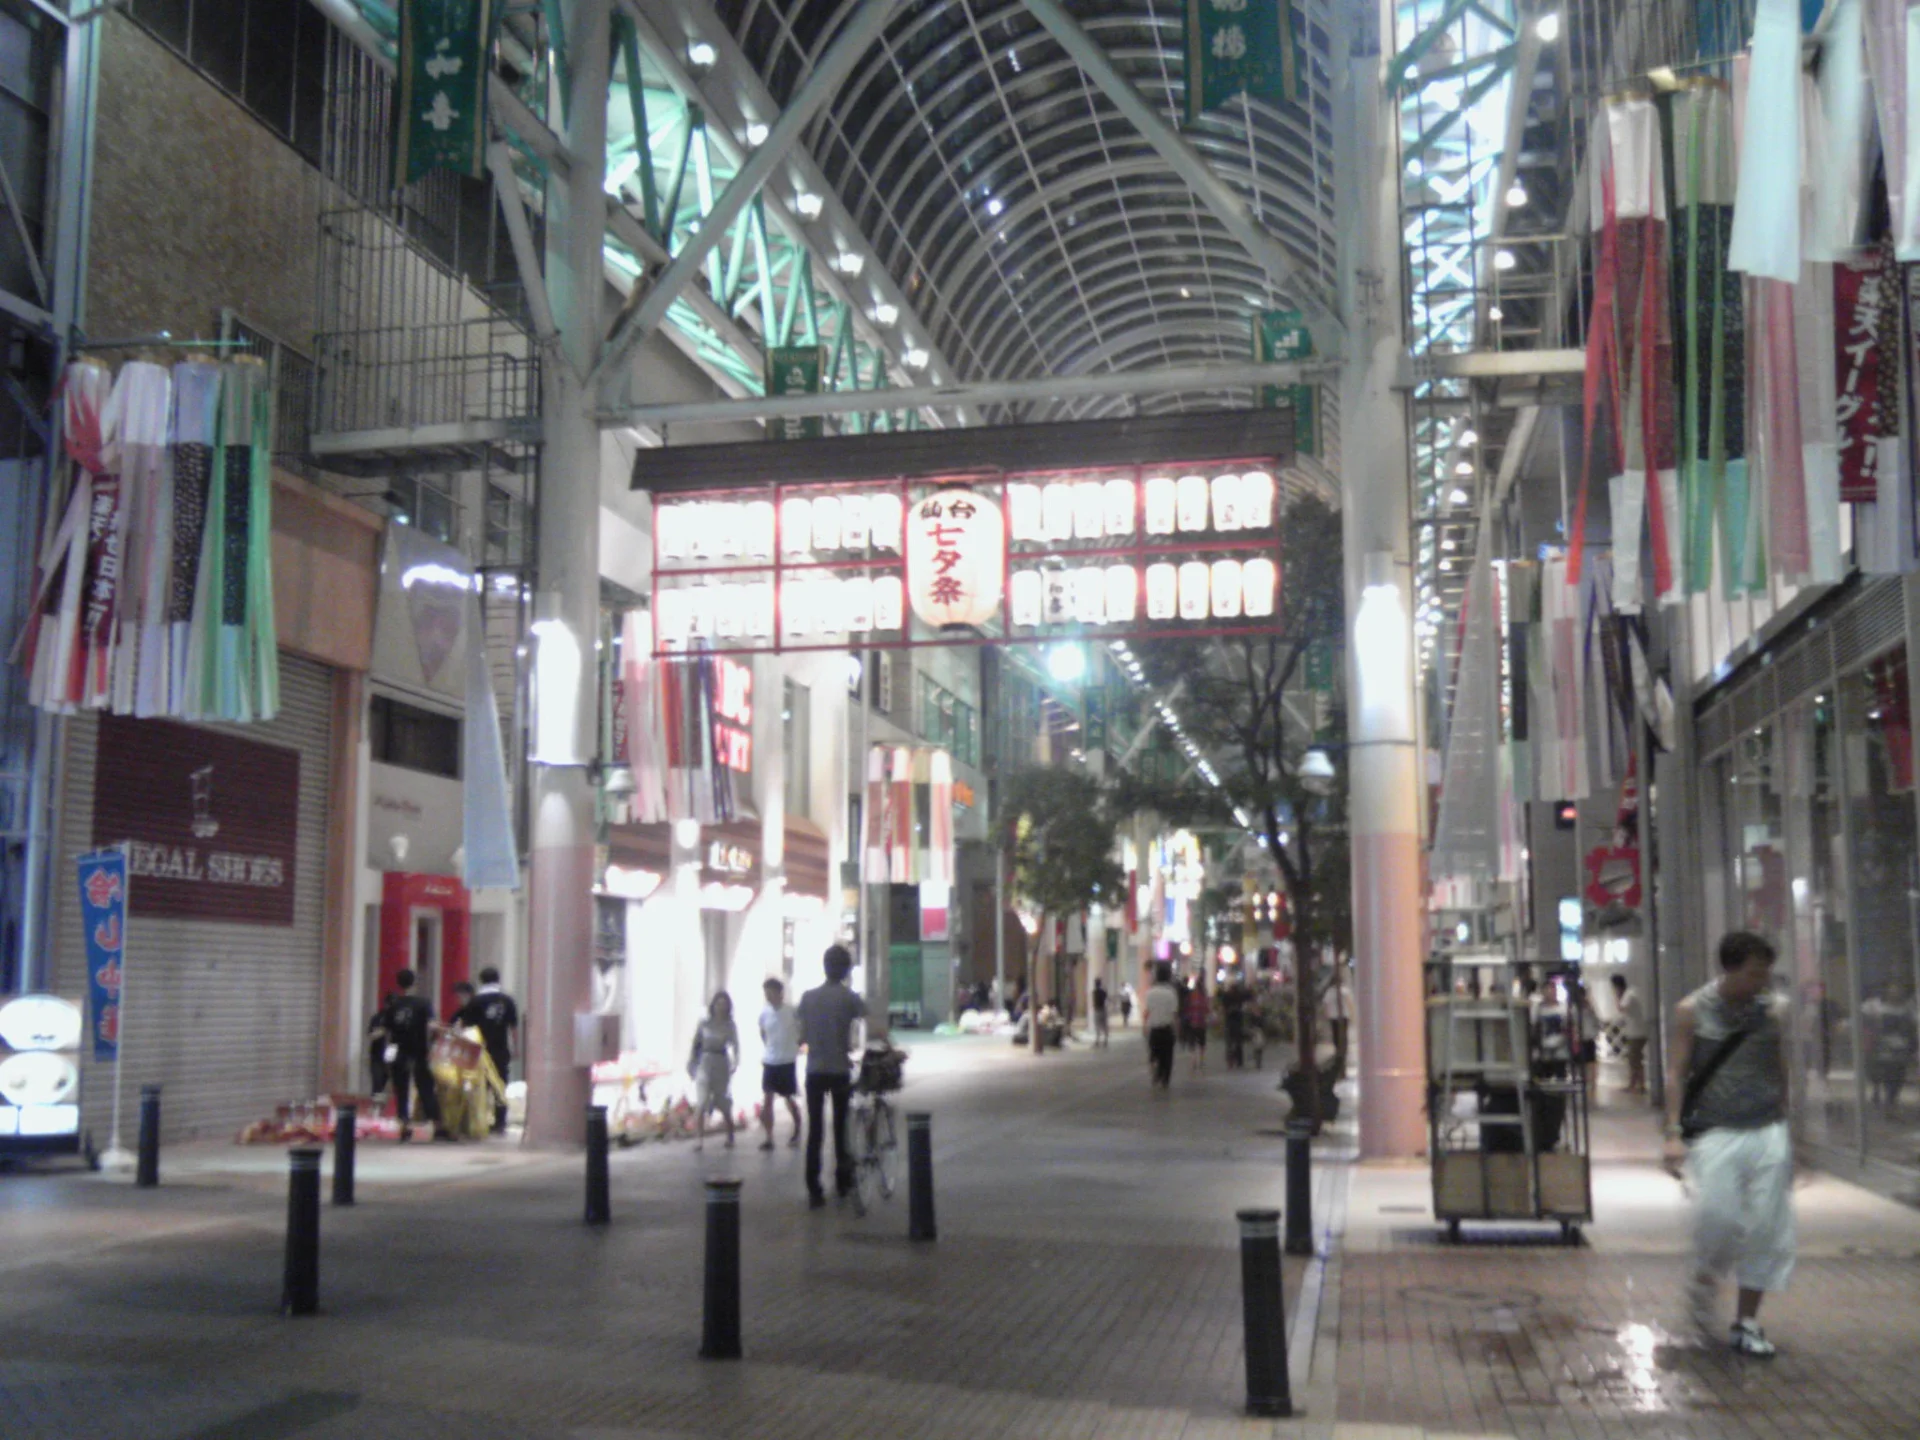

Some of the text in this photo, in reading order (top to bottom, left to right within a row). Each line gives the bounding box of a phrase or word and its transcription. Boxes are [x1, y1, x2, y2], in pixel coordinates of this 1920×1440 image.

[920, 500, 977, 519] 仙台
[926, 522, 966, 606] 七夕祭
[129, 843, 285, 888] EGAL SHOES
